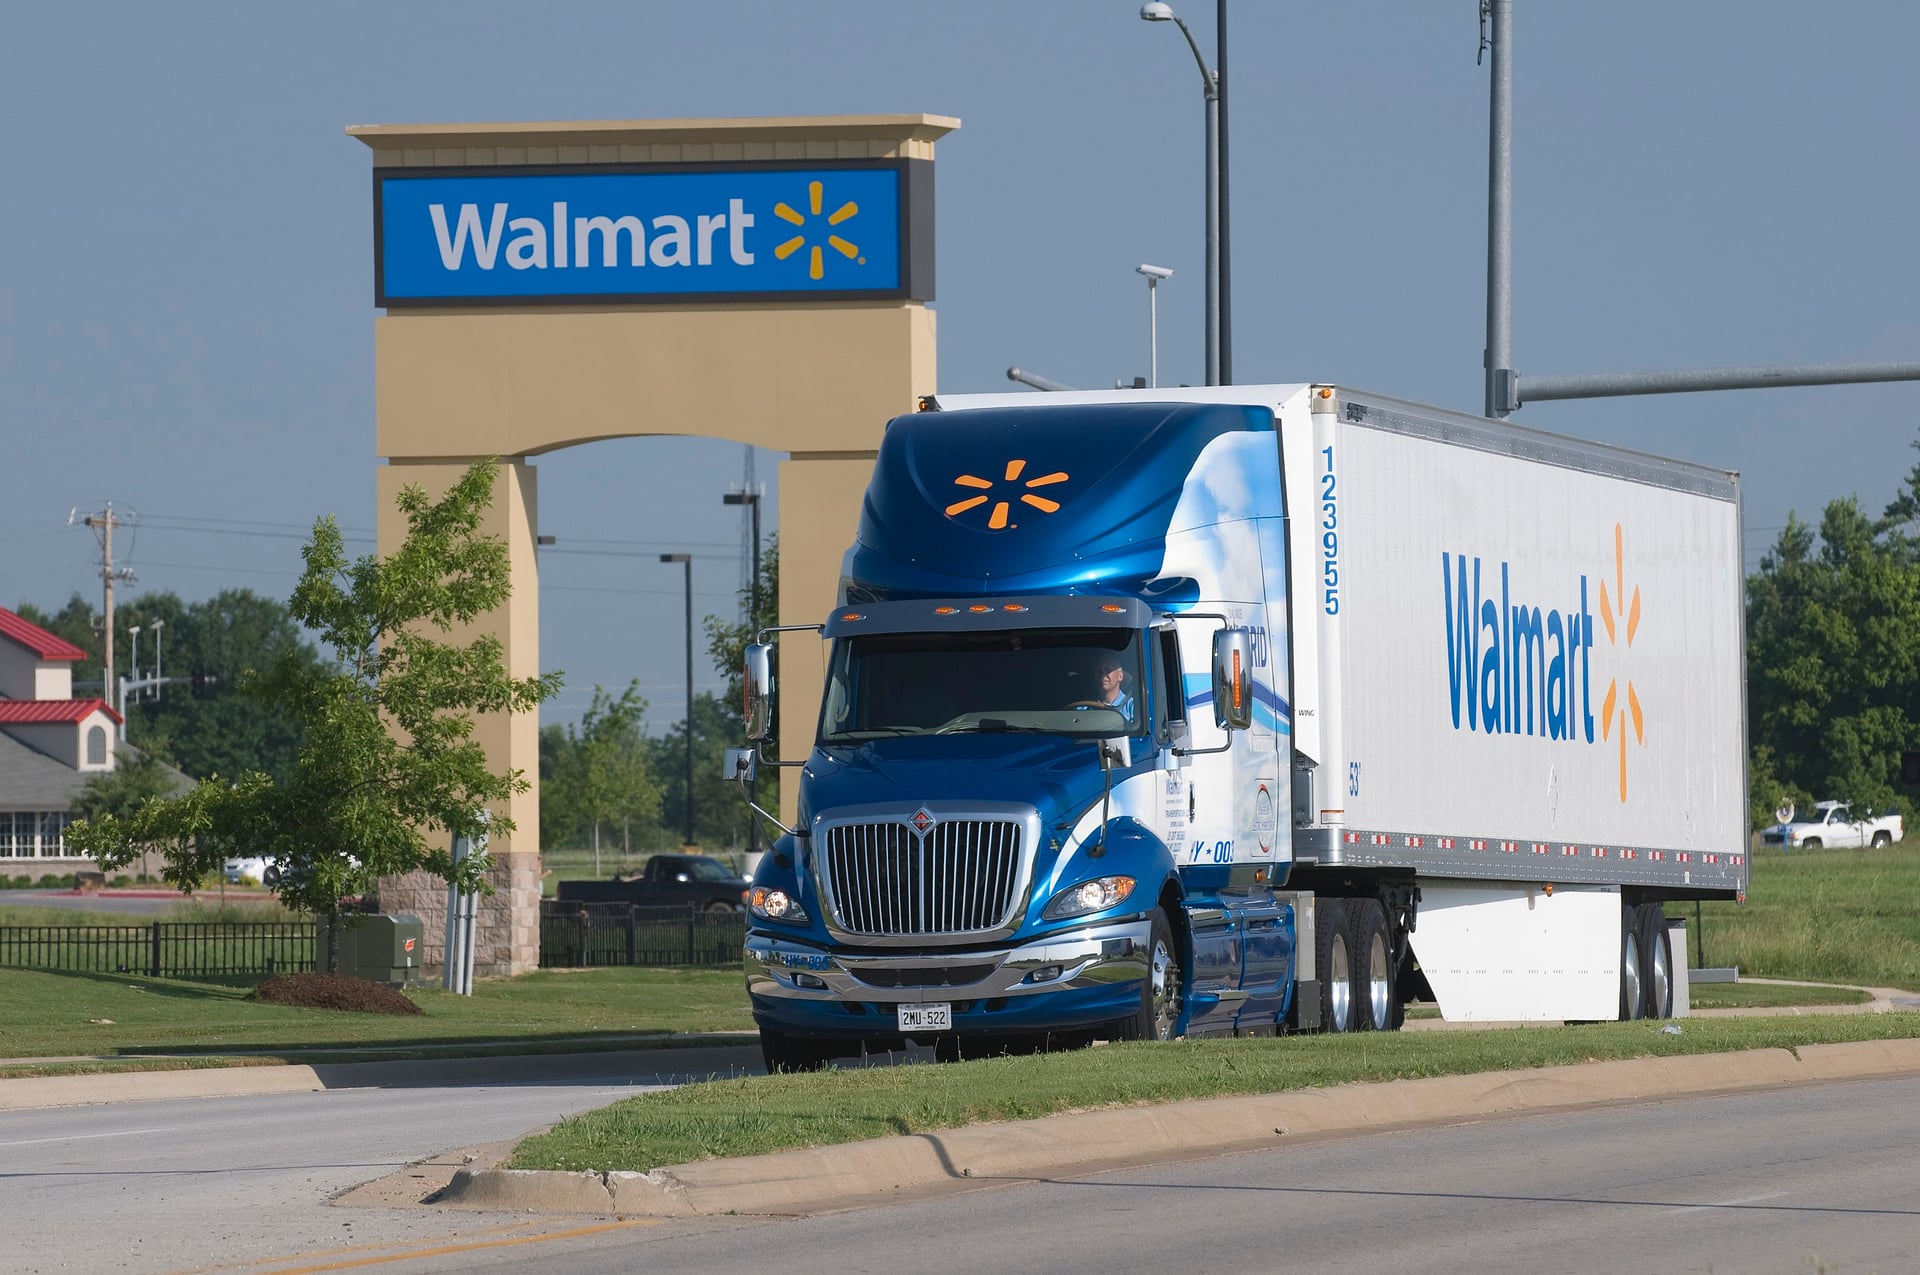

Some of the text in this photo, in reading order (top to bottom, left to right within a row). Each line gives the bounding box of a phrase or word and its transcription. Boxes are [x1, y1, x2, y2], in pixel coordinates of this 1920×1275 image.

[429, 198, 755, 271] Walmart
[1322, 446, 1339, 616] 123955
[1442, 551, 1594, 745] Walmart
[1298, 709, 1315, 717] WING
[903, 1011, 946, 1026] 2MU-522
